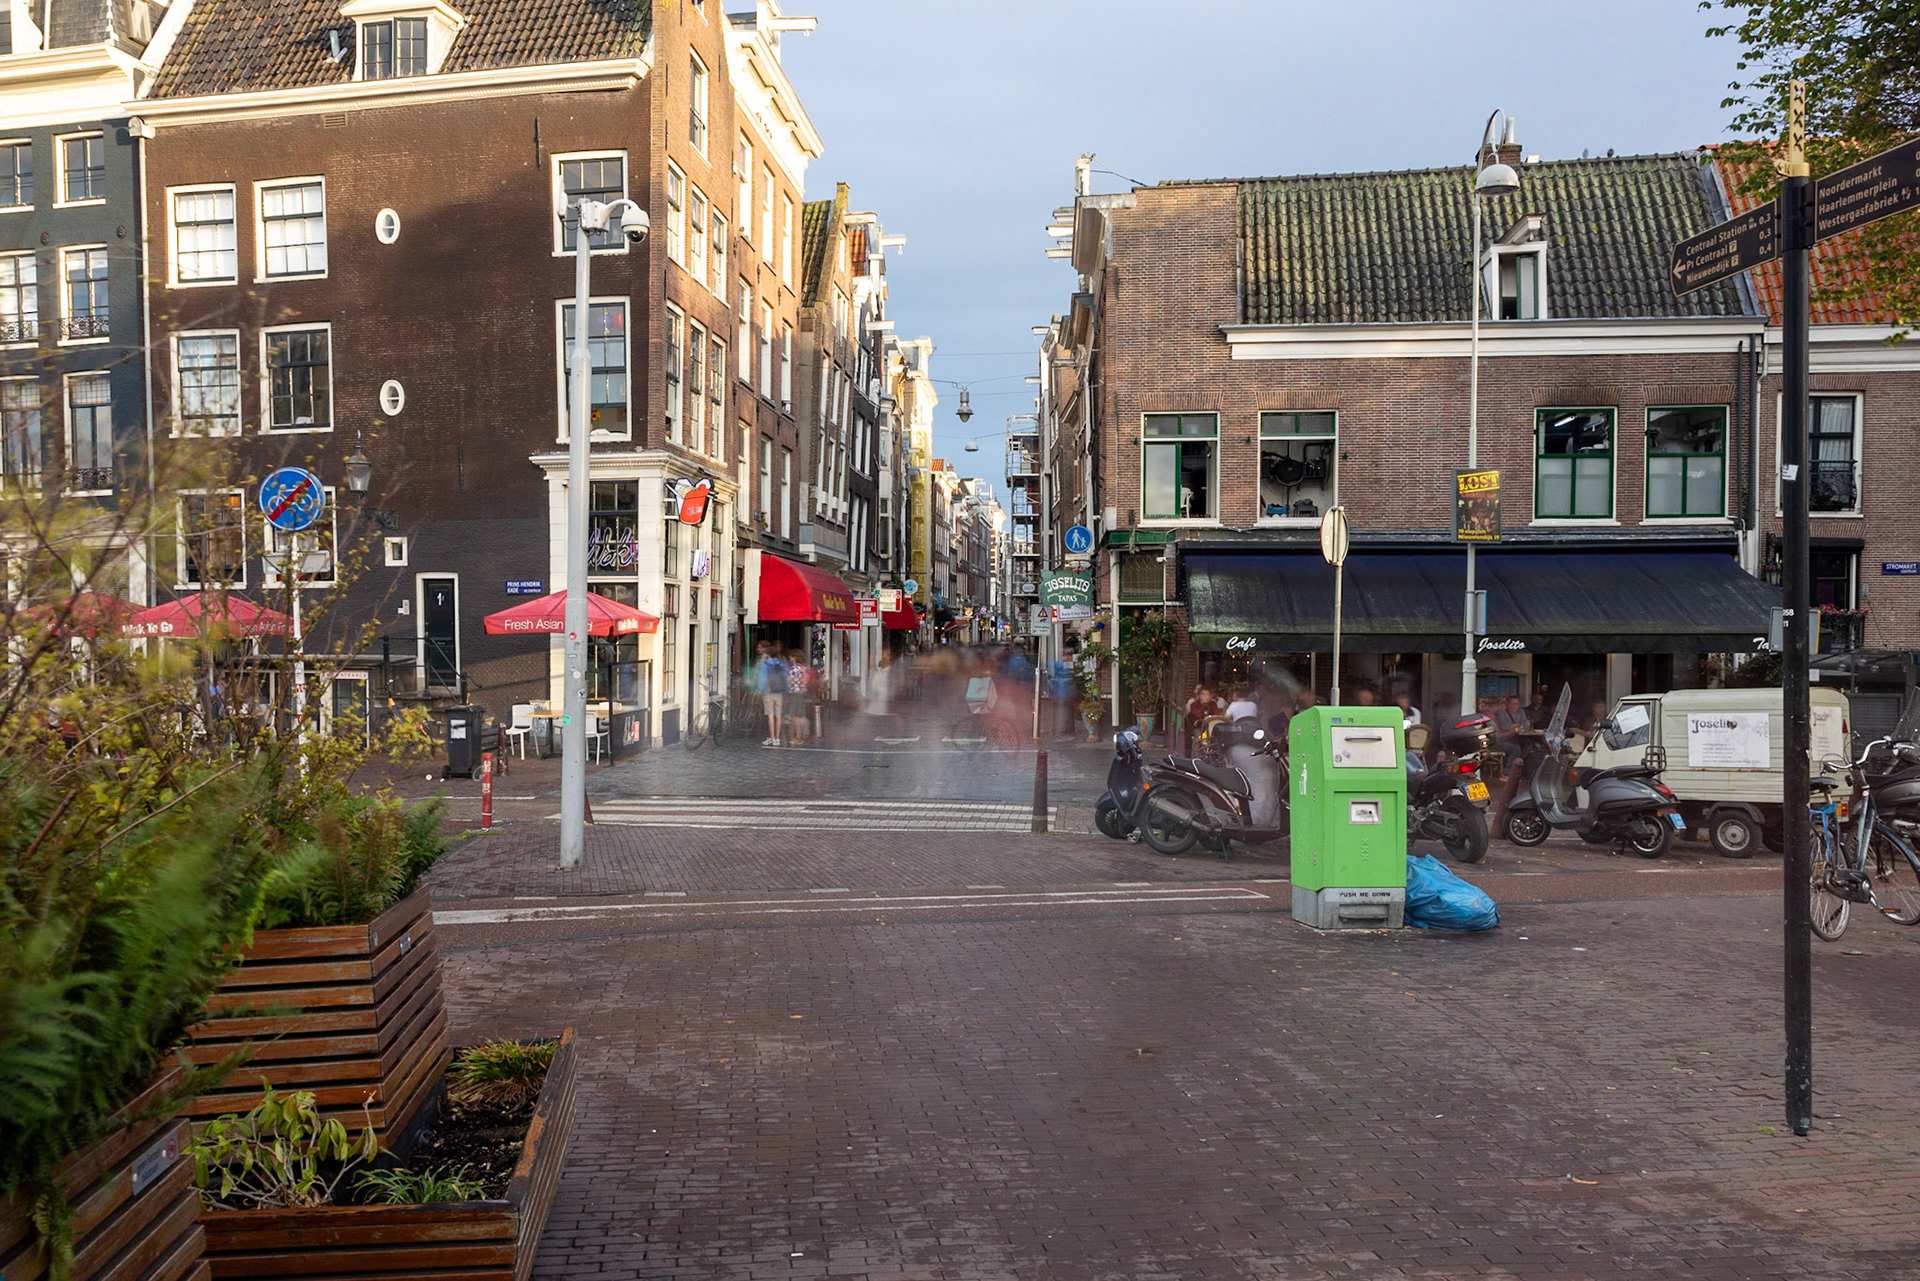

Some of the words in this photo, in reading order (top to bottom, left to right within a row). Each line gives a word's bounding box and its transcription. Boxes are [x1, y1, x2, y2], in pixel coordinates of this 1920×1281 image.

[1820, 166, 1882, 198] Noordermarkt
[1819, 178, 1898, 215] Haarlemmerplein
[1819, 193, 1899, 231] Westergasfabriek
[1686, 235, 1717, 256] Centraal
[1719, 223, 1747, 242] Station
[1759, 214, 1771, 225] 0,3
[1696, 245, 1728, 266] Centraal
[1759, 228, 1771, 240] 0,3
[1686, 260, 1730, 284] Nieuwendijk
[1759, 243, 1772, 255] 0,4
[1458, 473, 1499, 490] LOST
[520, 580, 541, 588] HENDRIK
[1044, 576, 1091, 593] JOSELITO
[1058, 594, 1078, 602] TAPAS
[160, 621, 174, 633] Go
[504, 619, 534, 631] Fresh
[535, 618, 564, 630] Asian
[1226, 635, 1257, 651] Café
[1477, 637, 1526, 653] Joselito
[1752, 637, 1770, 650] Ta
[1692, 719, 1738, 734] Joselito
